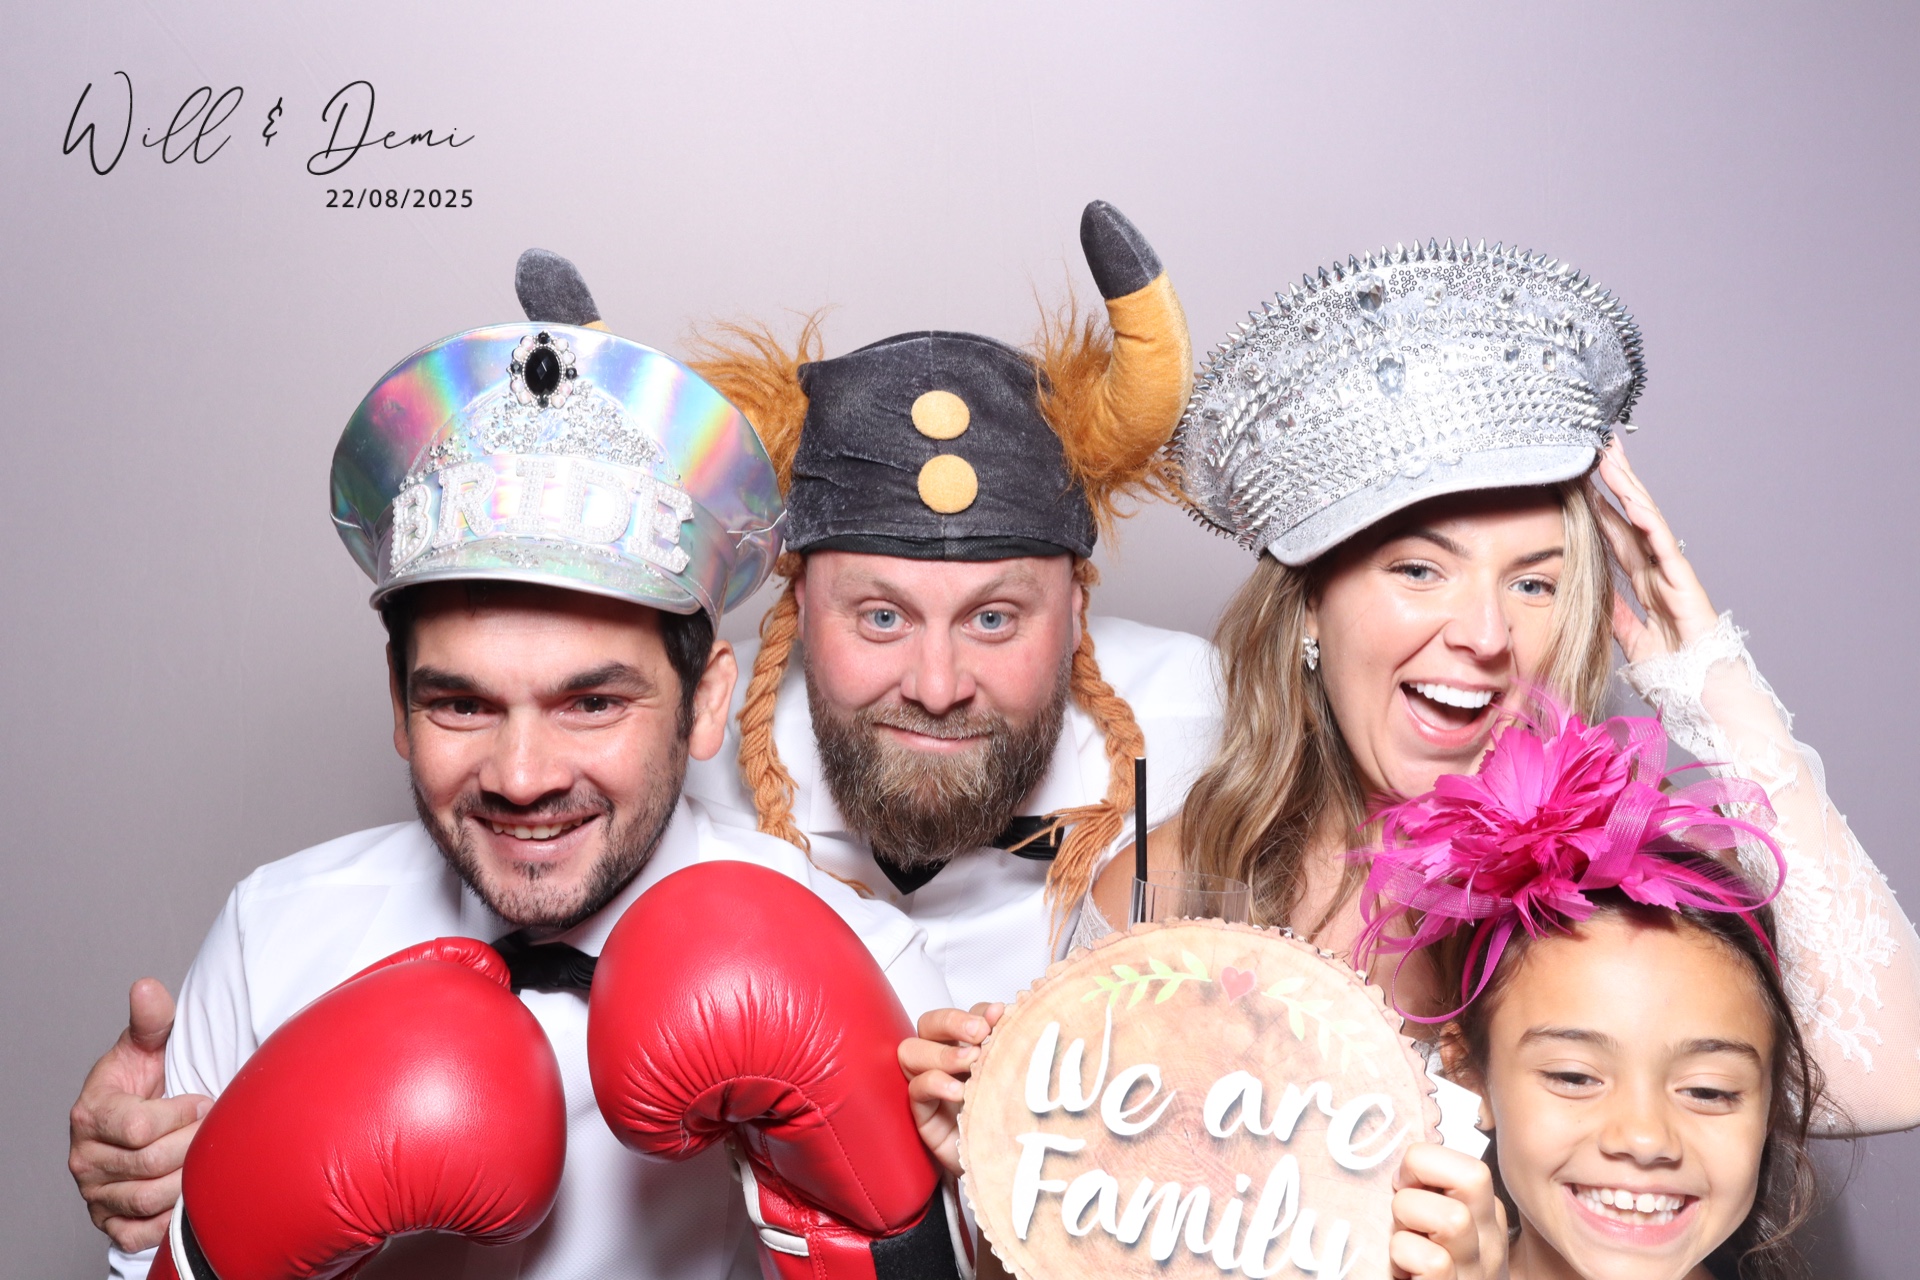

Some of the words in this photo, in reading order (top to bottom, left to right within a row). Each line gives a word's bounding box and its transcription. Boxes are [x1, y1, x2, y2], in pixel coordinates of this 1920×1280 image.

[390, 457, 695, 576] BRIDE
[1024, 1003, 1177, 1137] We
[1202, 1069, 1411, 1172] are
[1011, 1131, 1363, 1280] Family
